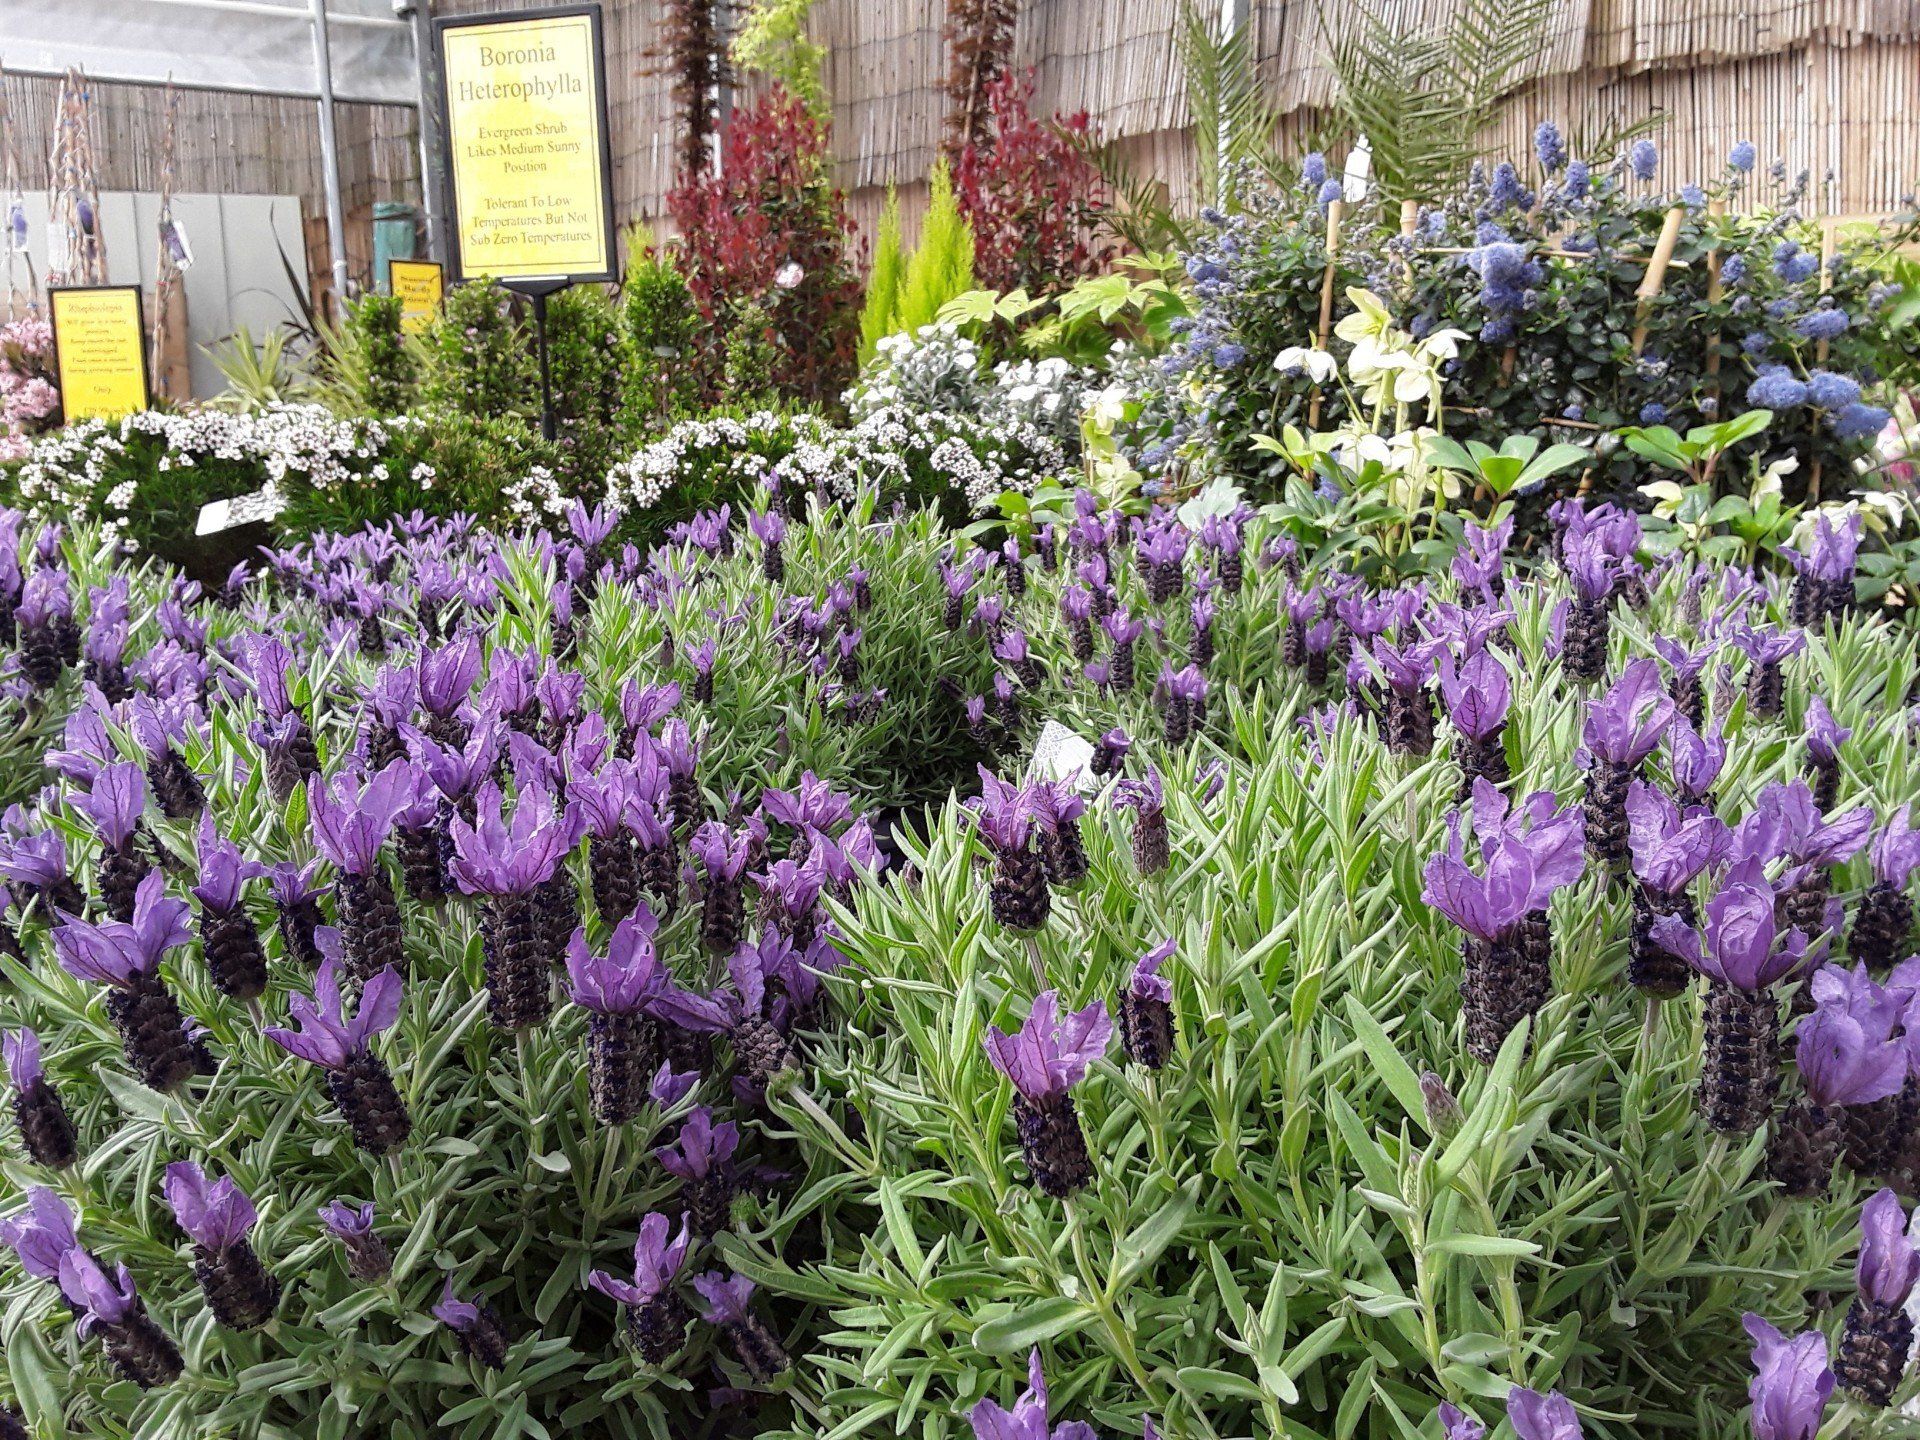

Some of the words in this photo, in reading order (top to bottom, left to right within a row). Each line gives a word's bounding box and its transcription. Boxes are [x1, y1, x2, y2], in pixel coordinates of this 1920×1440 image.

[480, 41, 555, 67] Boronia
[459, 72, 581, 102] Heterophylla
[479, 126, 533, 140] Evergreen
[535, 122, 567, 135] Shrub
[467, 146, 496, 157] Likes
[500, 143, 544, 155] Medium
[547, 140, 580, 154] Sunny
[503, 160, 547, 173] Position
[484, 198, 528, 210] Tolerant
[531, 196, 545, 208] To
[548, 195, 571, 207] Low
[472, 215, 542, 229] Temperatures
[545, 212, 564, 225] But
[568, 211, 587, 223] Not
[470, 233, 491, 246] Sub
[493, 233, 518, 245] Zero
[521, 231, 592, 246] Temperatures
